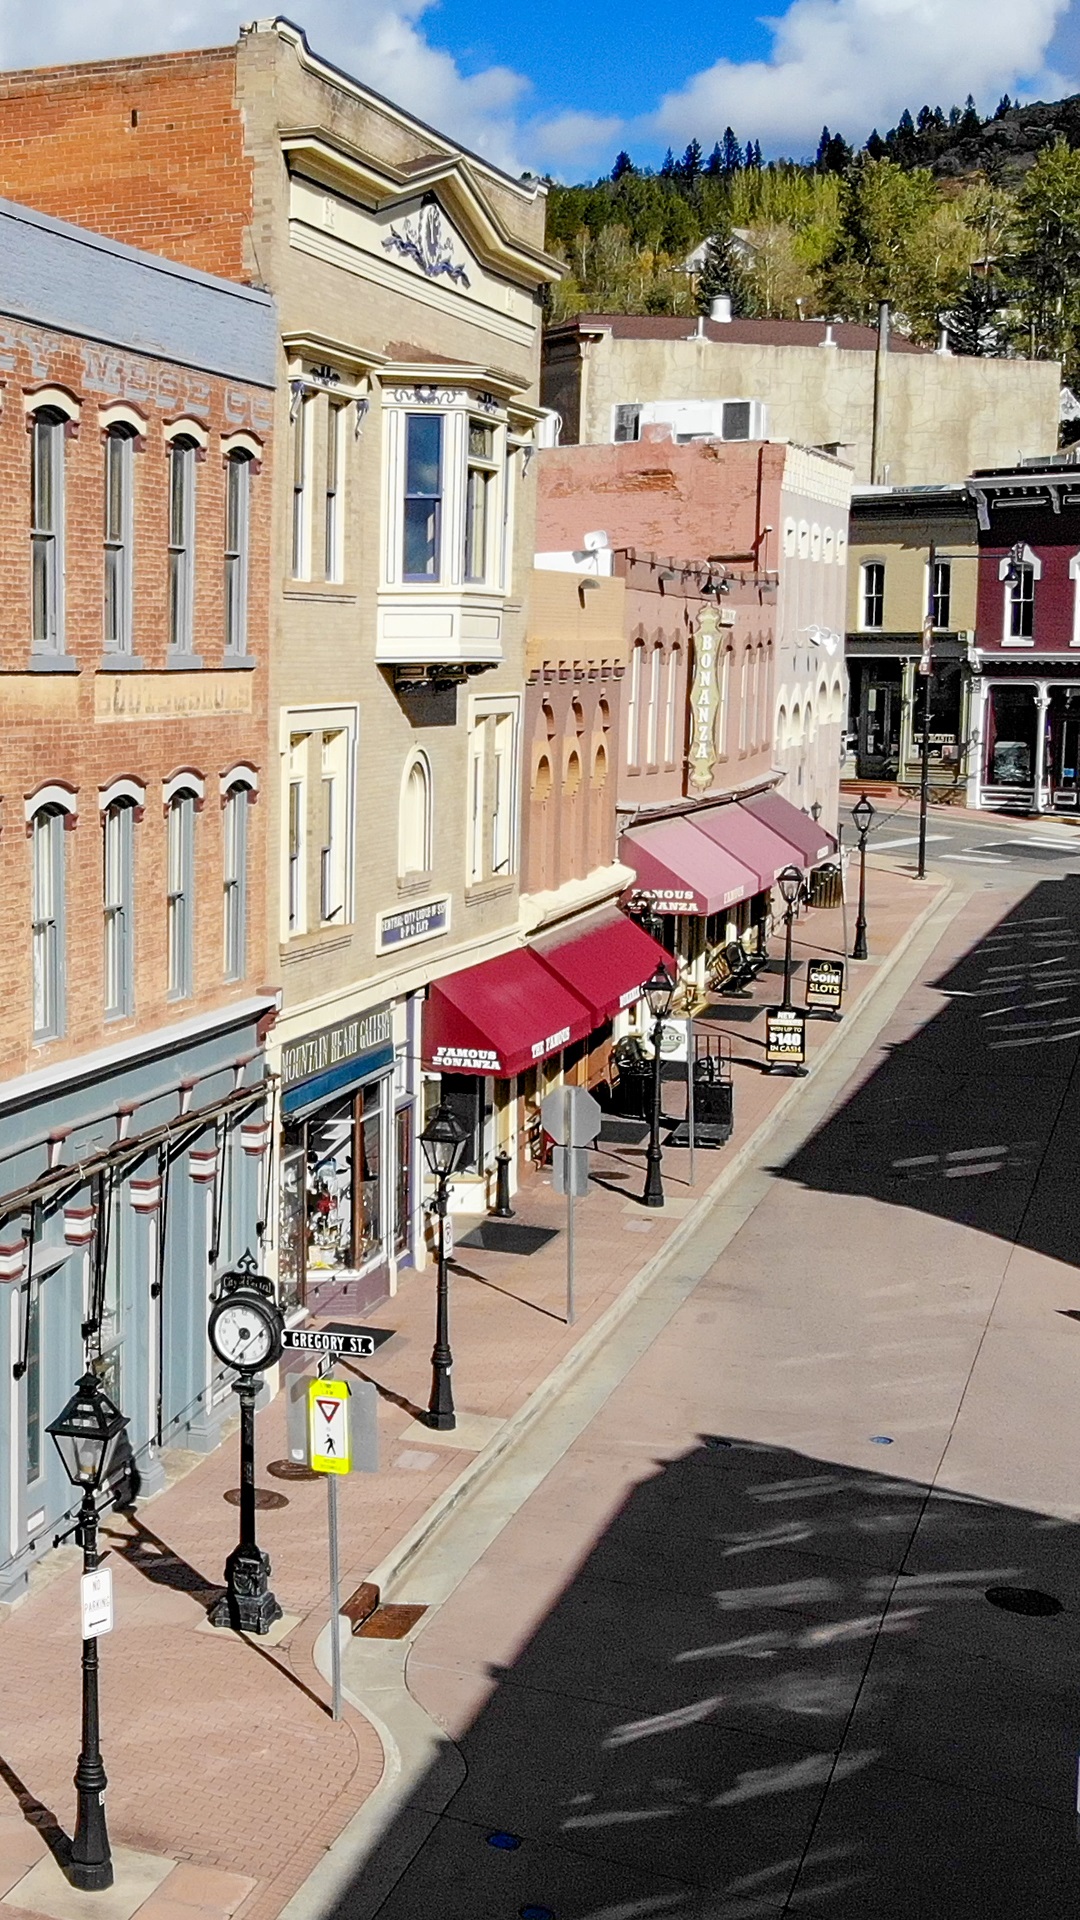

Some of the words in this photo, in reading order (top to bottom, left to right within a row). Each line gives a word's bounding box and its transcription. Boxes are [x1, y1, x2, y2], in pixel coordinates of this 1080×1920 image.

[695, 634, 713, 759] BONANZA
[404, 911, 415, 925] CITY
[810, 972, 840, 985] COIN
[809, 983, 840, 994] SLOTS
[777, 1011, 797, 1020] NEW
[769, 1032, 802, 1046] $140
[282, 1034, 330, 1085] MOUNTAIN
[330, 1022, 359, 1063] HEART
[359, 1010, 391, 1050] GALLERY
[437, 1046, 497, 1060] FAMOUS
[780, 1045, 801, 1053] CASH
[432, 1056, 501, 1070] BONANZA
[223, 1276, 238, 1290] City
[292, 1332, 345, 1351] GREGORY
[350, 1338, 366, 1353] ST.
[92, 1579, 101, 1592] NO
[84, 1595, 110, 1614] PARKING
